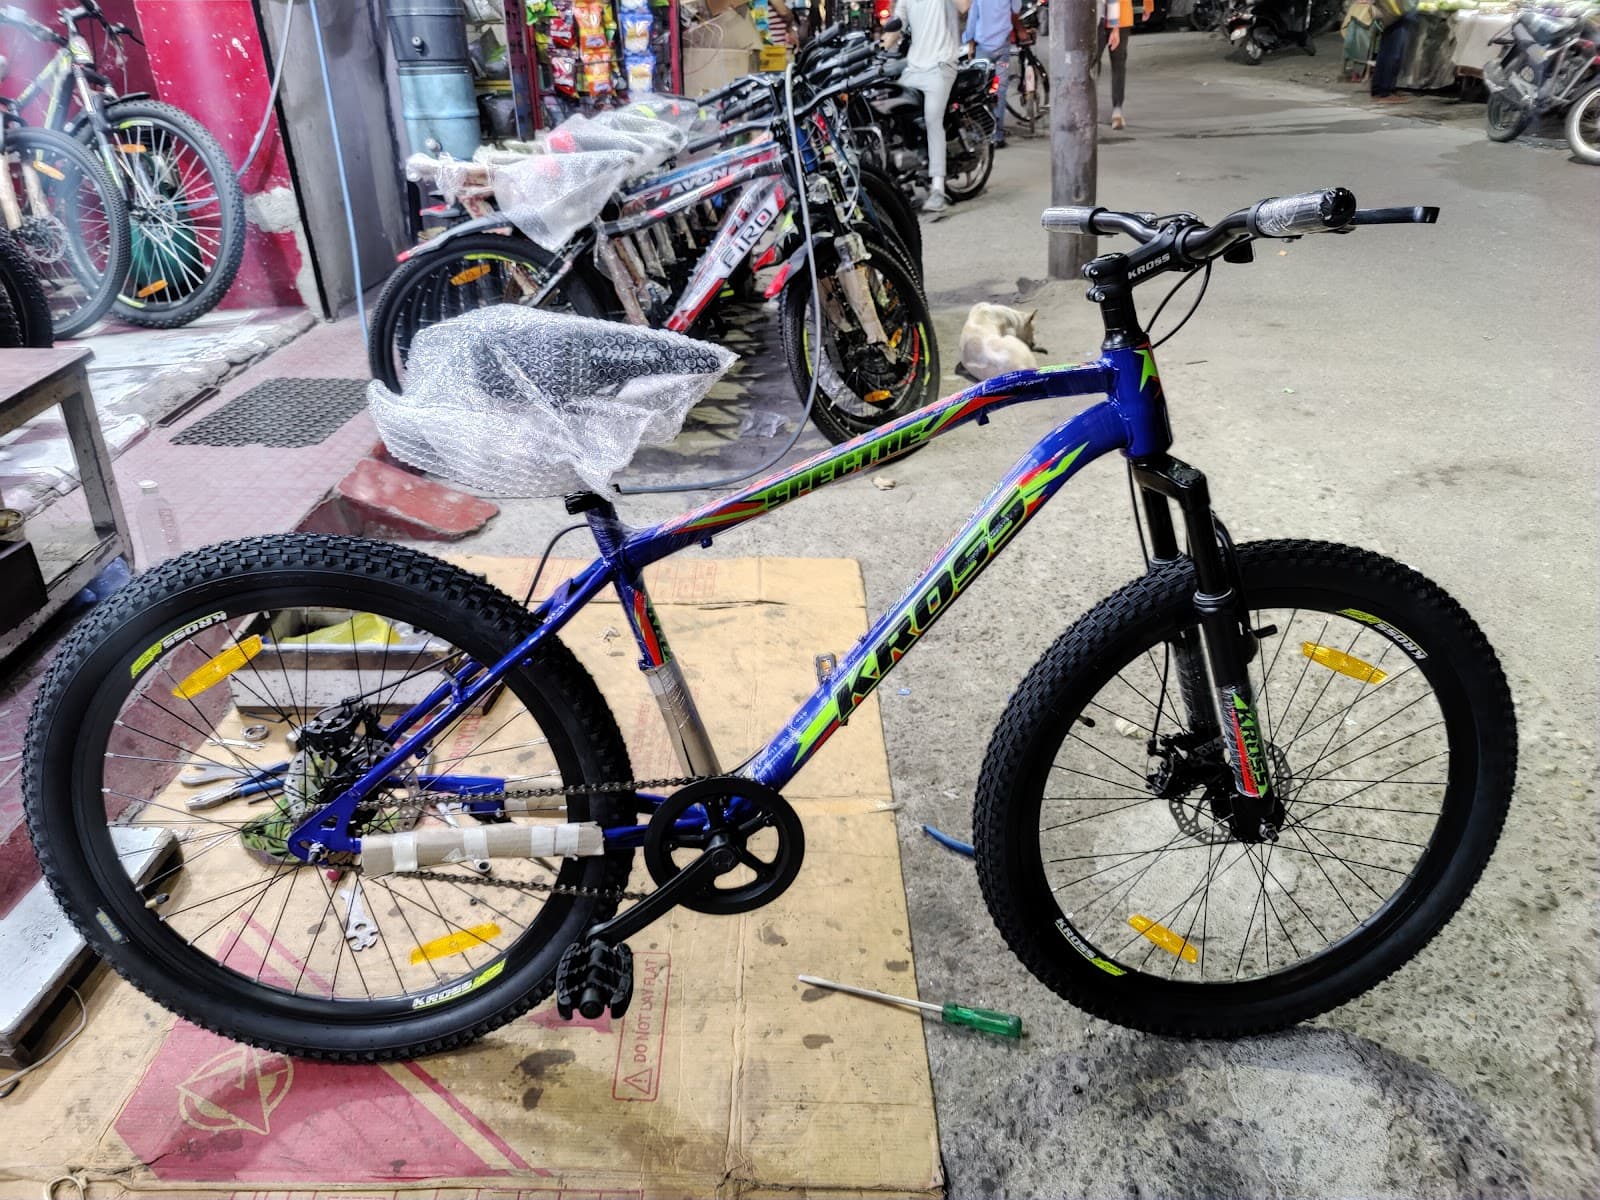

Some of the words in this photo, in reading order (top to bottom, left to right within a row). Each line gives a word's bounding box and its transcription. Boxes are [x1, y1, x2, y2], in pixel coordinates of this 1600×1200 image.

[670, 166, 729, 196] AVON
[1127, 252, 1171, 280] KROSS
[834, 485, 1028, 722] KROSS
[162, 609, 228, 649] KROSS
[1373, 622, 1428, 660] KROSS
[1239, 708, 1268, 787] KROSS
[1055, 918, 1097, 959] KROSS
[644, 958, 657, 986] FLAT
[412, 979, 474, 1009] KROSS
[640, 988, 654, 1012] LAY
[637, 1013, 651, 1041] NOT
[633, 1043, 648, 1064] DO
